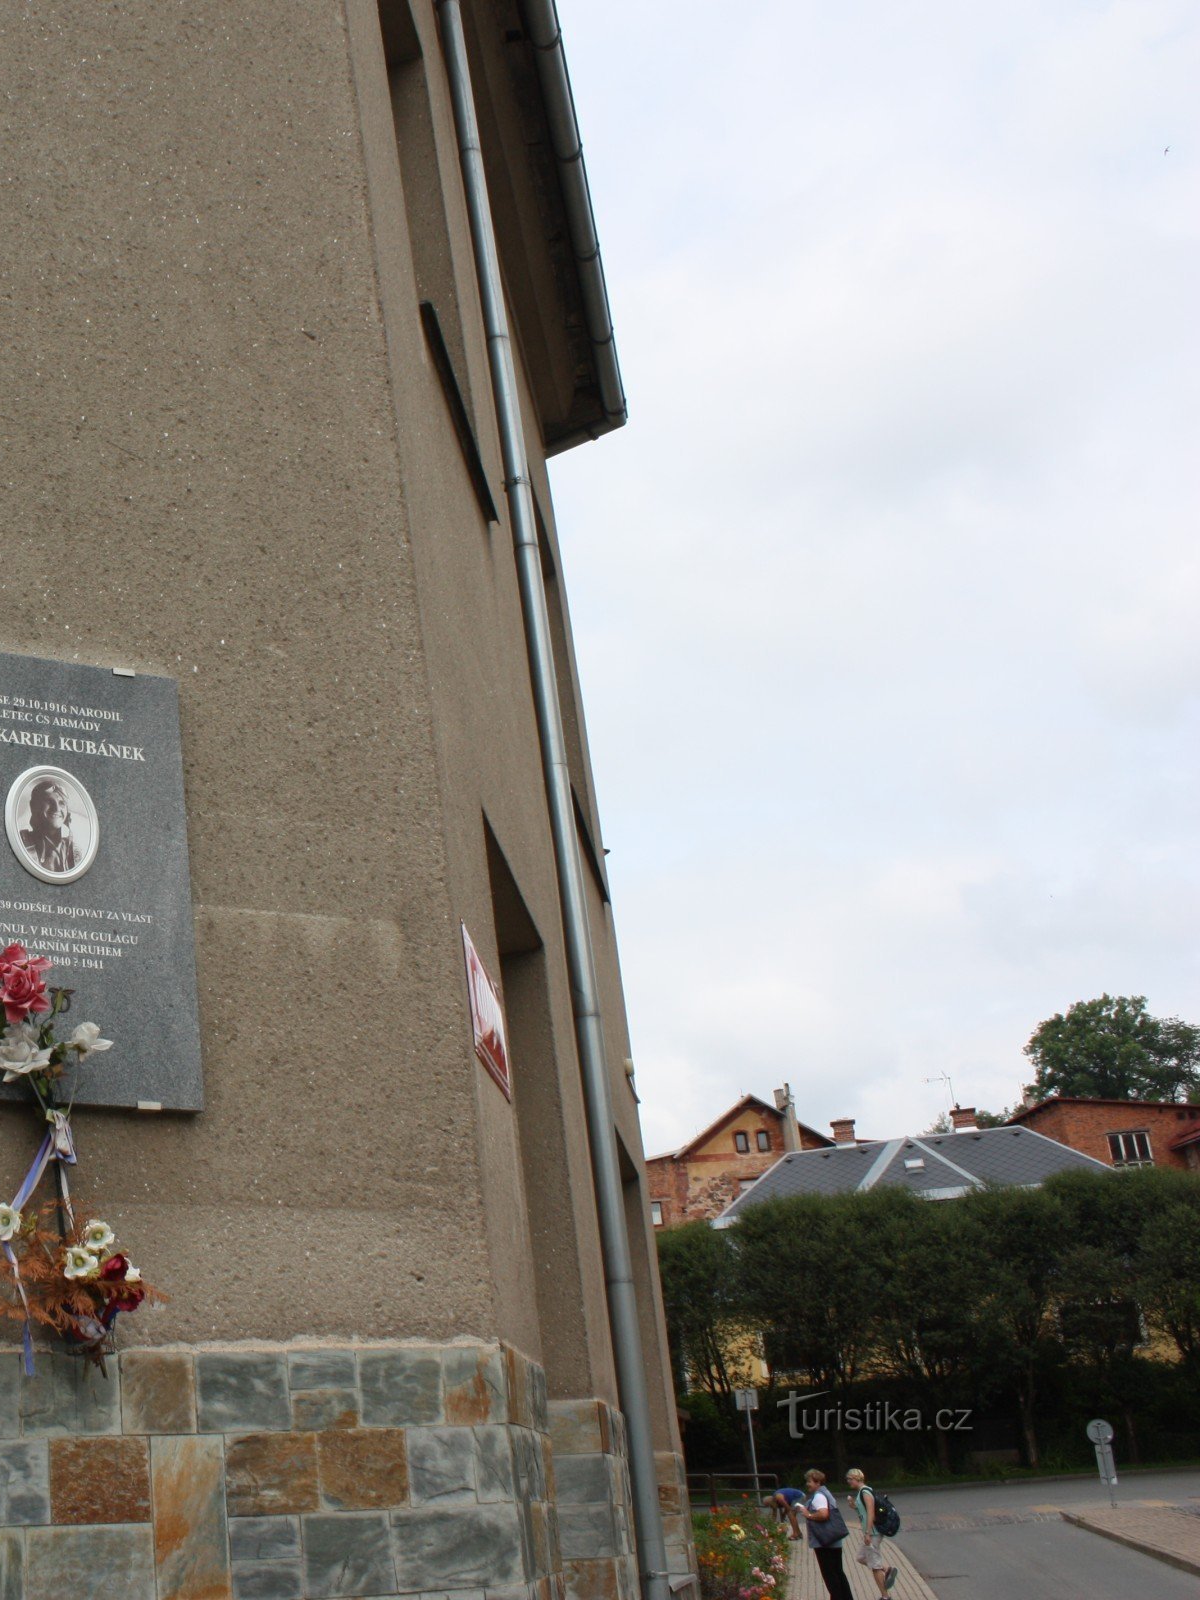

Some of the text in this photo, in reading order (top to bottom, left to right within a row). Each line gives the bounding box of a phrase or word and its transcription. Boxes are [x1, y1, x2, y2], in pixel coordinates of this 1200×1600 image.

[13, 697, 67, 714] 29.10.1916
[70, 705, 123, 722] NARODIL
[35, 712, 50, 725] ČS
[53, 716, 101, 732] ARMÁDY
[59, 736, 146, 762] KUBÁNEK
[13, 900, 55, 914] ODEŠEL
[57, 906, 104, 919] BOJOVAT
[106, 911, 119, 920] ZA
[121, 912, 153, 924] VLAST
[30, 925, 38, 935] V
[41, 926, 87, 941] RUSKÉM
[90, 932, 139, 945] GULAGU
[72, 943, 122, 957] KRUHEM
[49, 956, 71, 967] 1940
[81, 958, 103, 970] 1941
